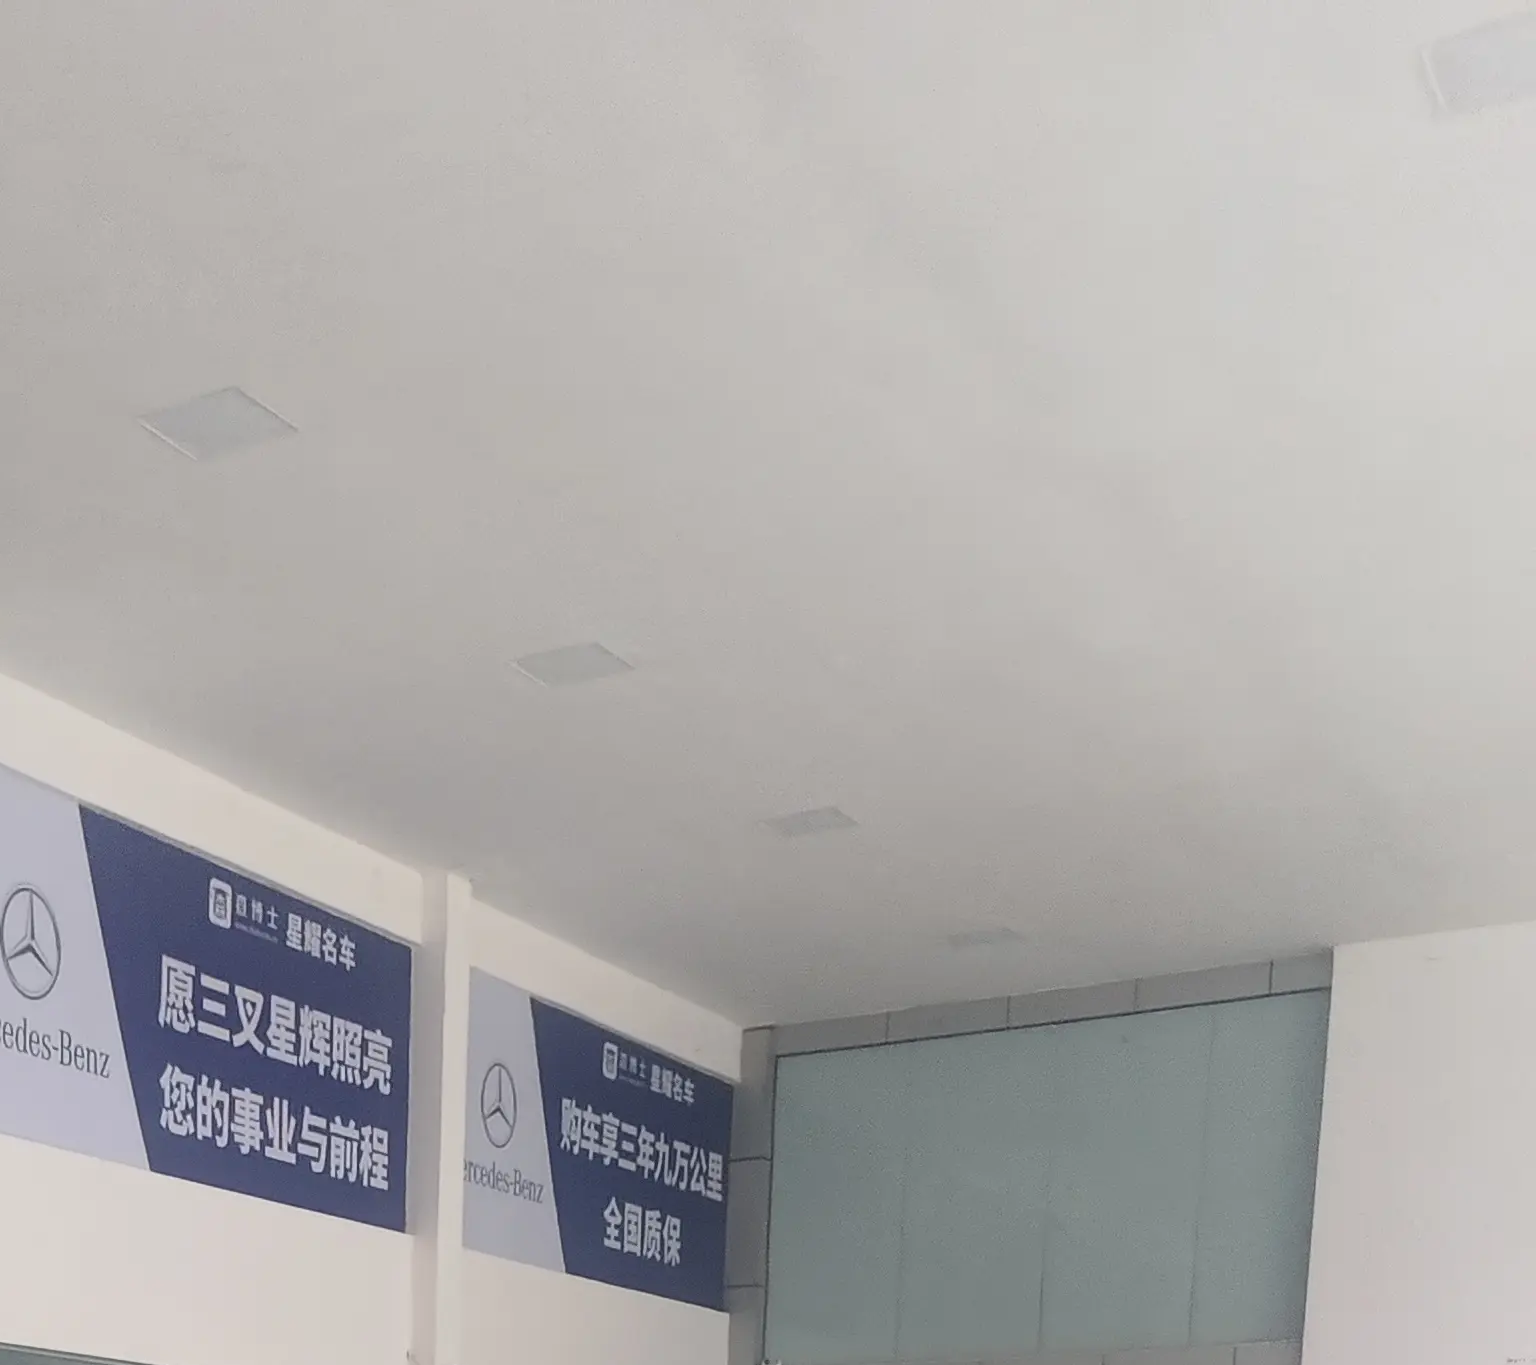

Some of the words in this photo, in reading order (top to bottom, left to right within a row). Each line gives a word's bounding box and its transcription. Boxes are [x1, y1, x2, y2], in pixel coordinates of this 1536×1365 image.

[157, 954, 393, 1096] 愿三叉星辉照亮
[159, 1063, 389, 1192] 您的事业与前程
[560, 1097, 723, 1201] 购车享三年九万公里
[603, 1196, 682, 1267] 全国质保
